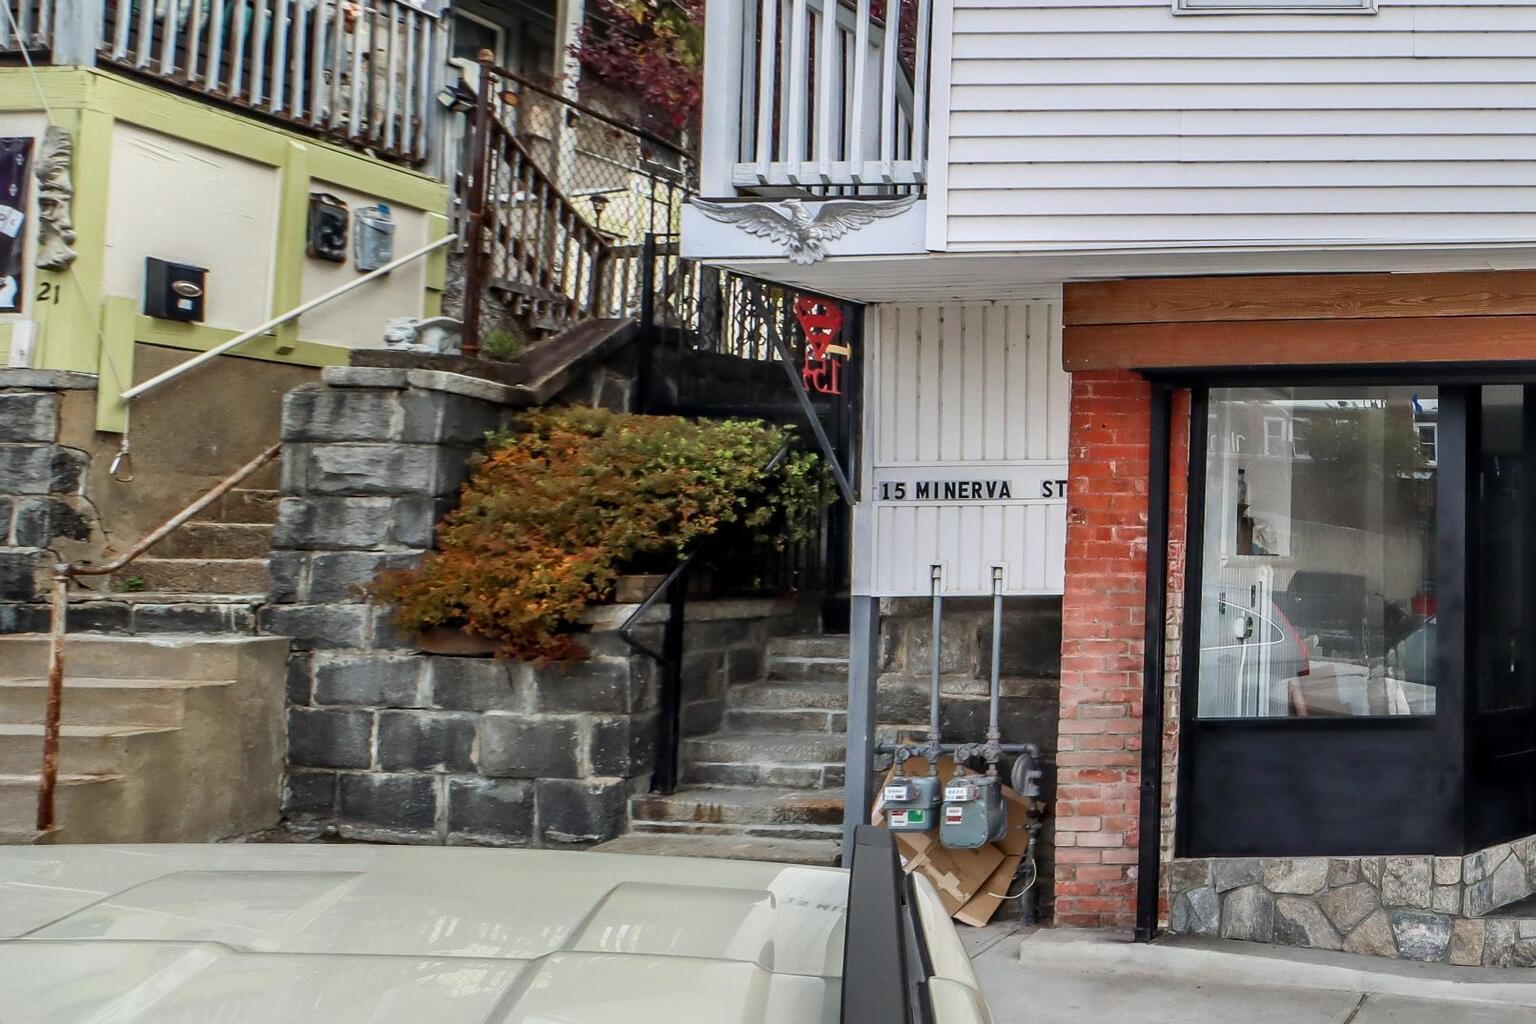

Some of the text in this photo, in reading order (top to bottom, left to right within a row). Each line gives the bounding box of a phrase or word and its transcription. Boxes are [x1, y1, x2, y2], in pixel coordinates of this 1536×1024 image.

[36, 282, 60, 305] 21
[882, 480, 1067, 499] 15 MINERVA ST
